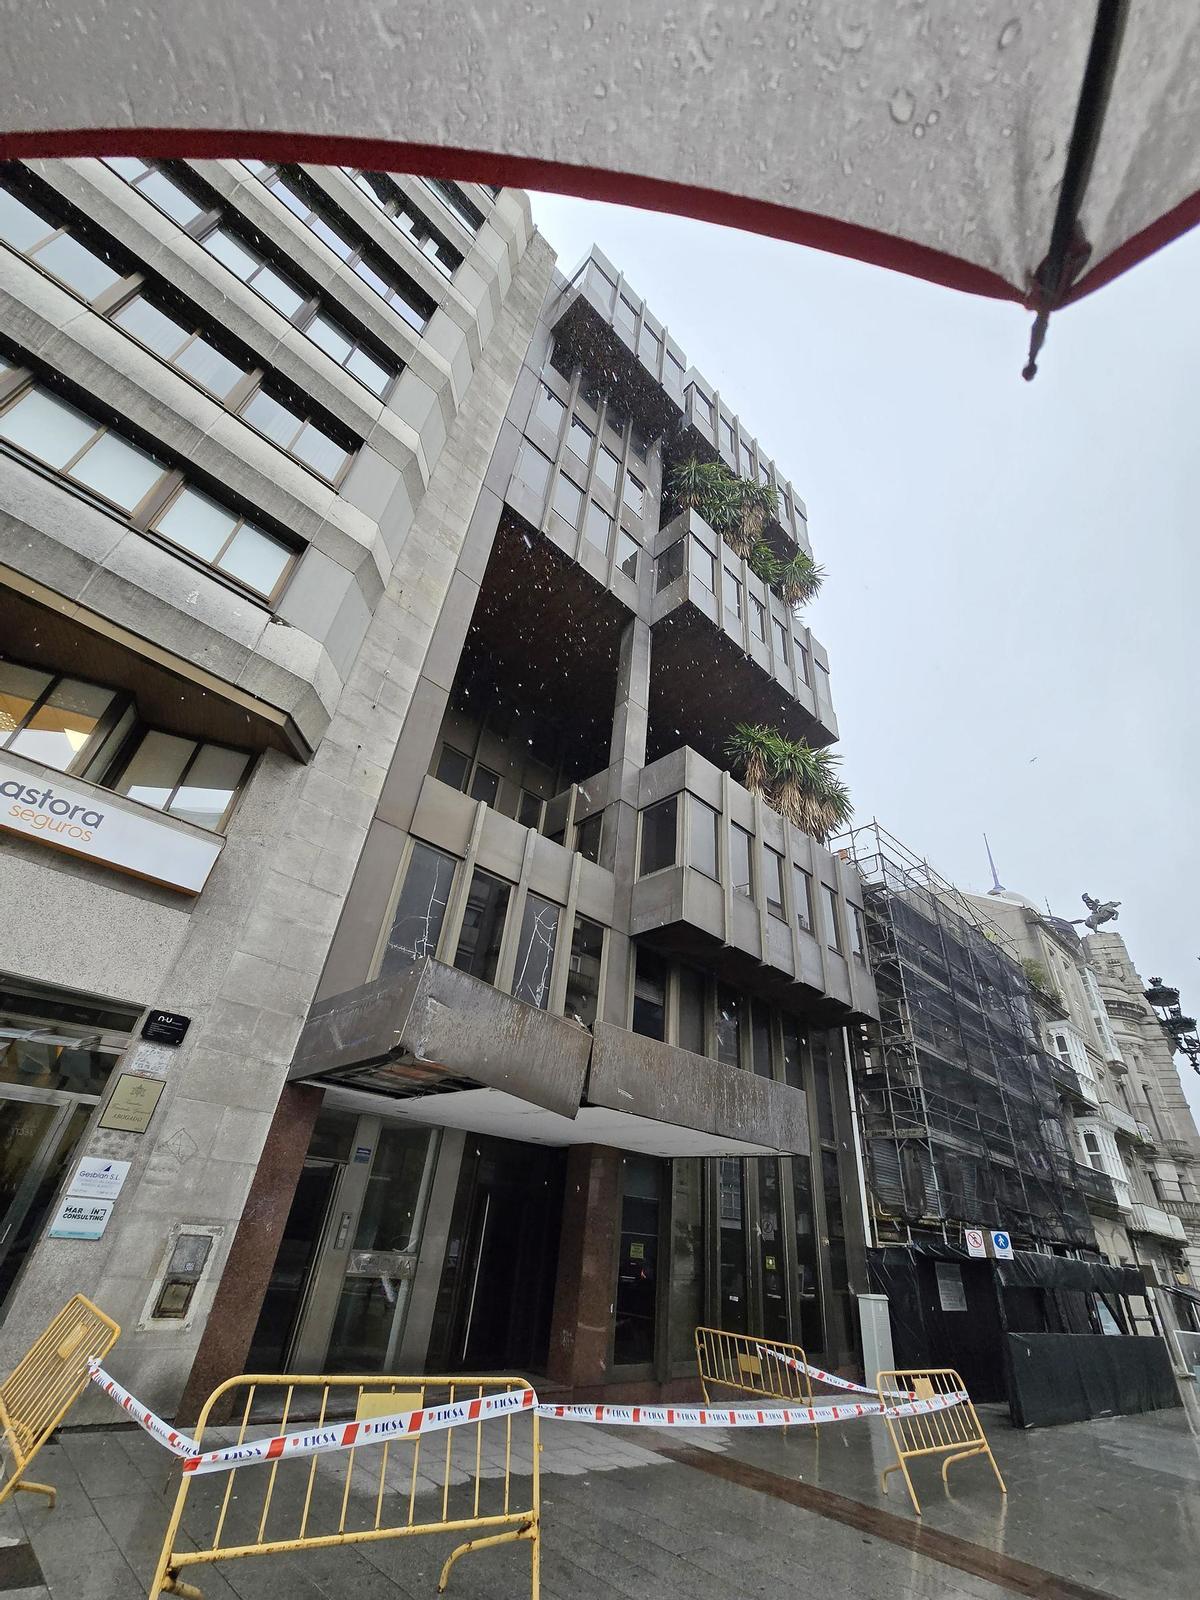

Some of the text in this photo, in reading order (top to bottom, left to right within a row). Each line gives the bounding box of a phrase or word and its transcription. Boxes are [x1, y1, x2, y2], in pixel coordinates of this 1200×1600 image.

[0, 780, 104, 829] astora
[8, 803, 93, 843] seguros
[63, 1213, 104, 1221] CONSULTING
[65, 1206, 84, 1214] MAR
[374, 1418, 404, 1434] DICSA
[303, 1431, 337, 1447] DICSA
